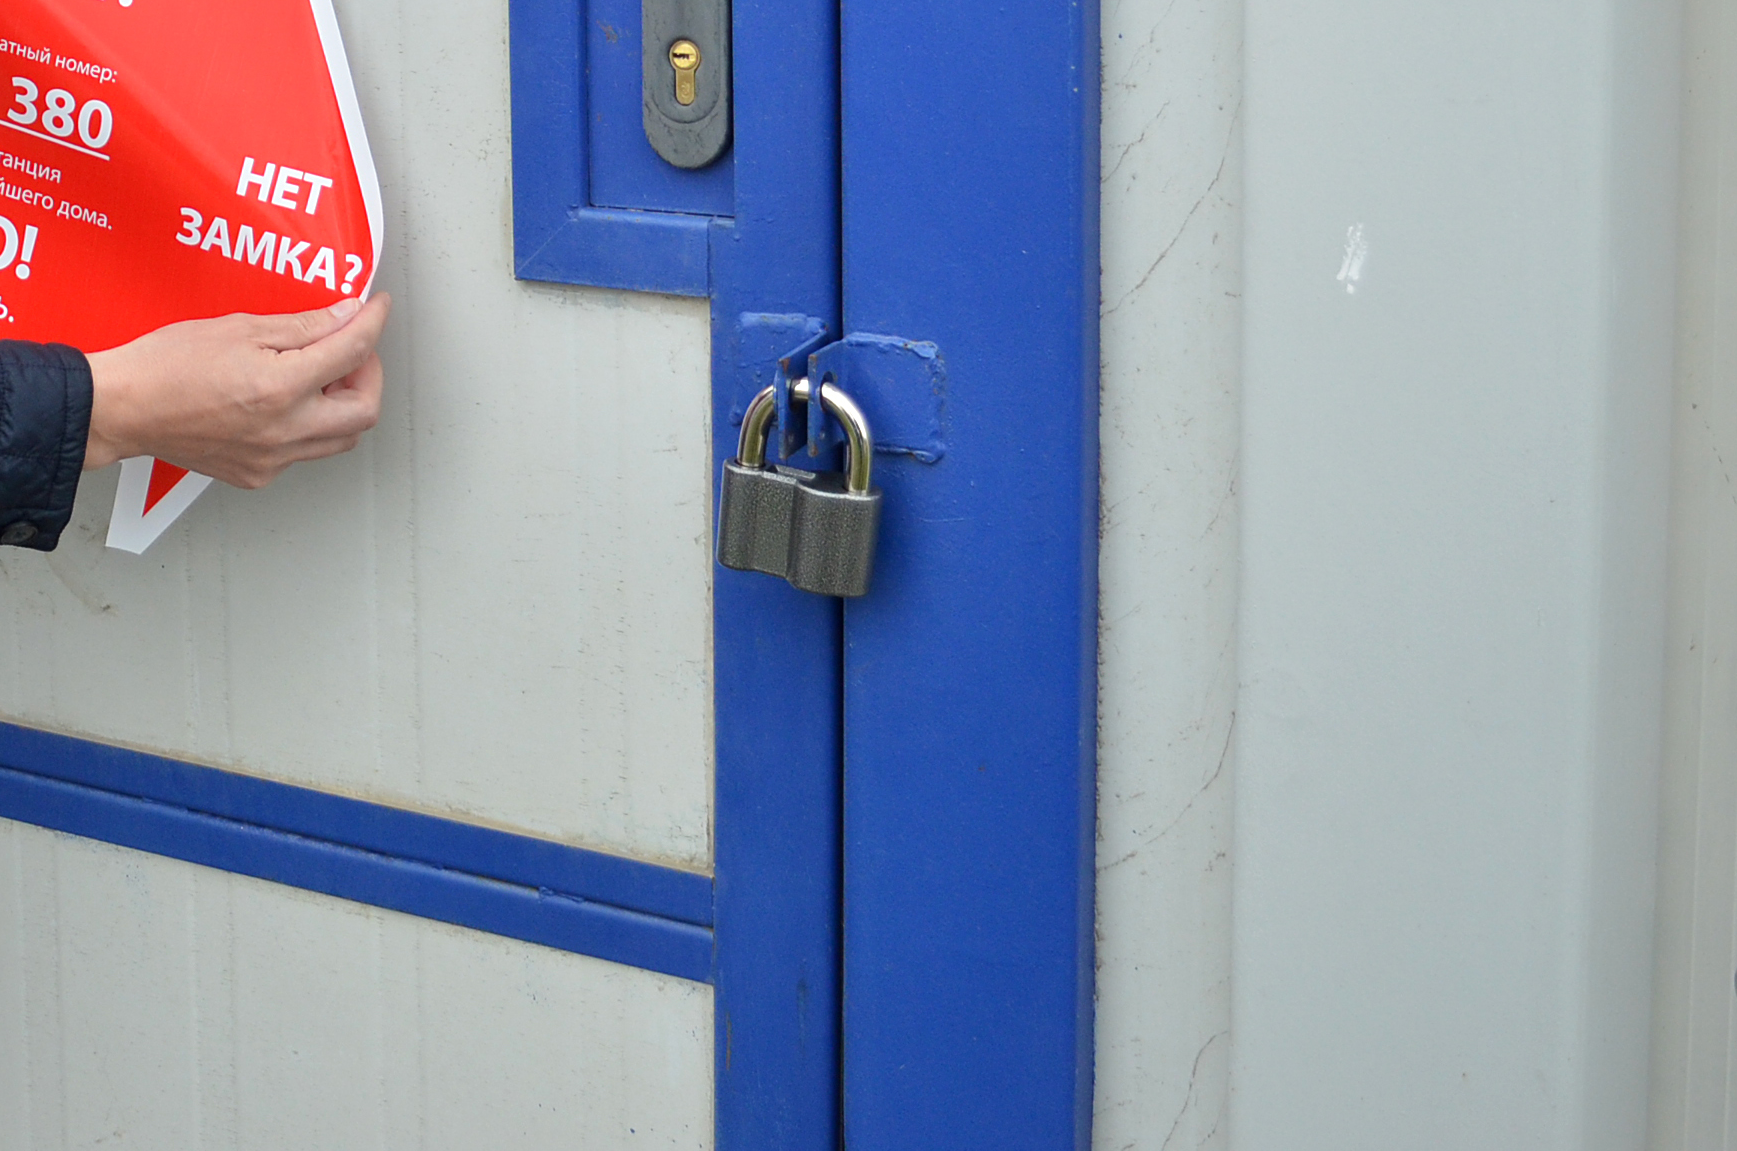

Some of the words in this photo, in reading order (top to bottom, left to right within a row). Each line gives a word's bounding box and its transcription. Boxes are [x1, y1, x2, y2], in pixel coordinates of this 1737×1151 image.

[55, 55, 118, 83] номер:
[7, 76, 113, 148] 380
[56, 200, 112, 230] дома.
[236, 156, 333, 215] НЕТ
[175, 207, 362, 294] ЗАМКА?
